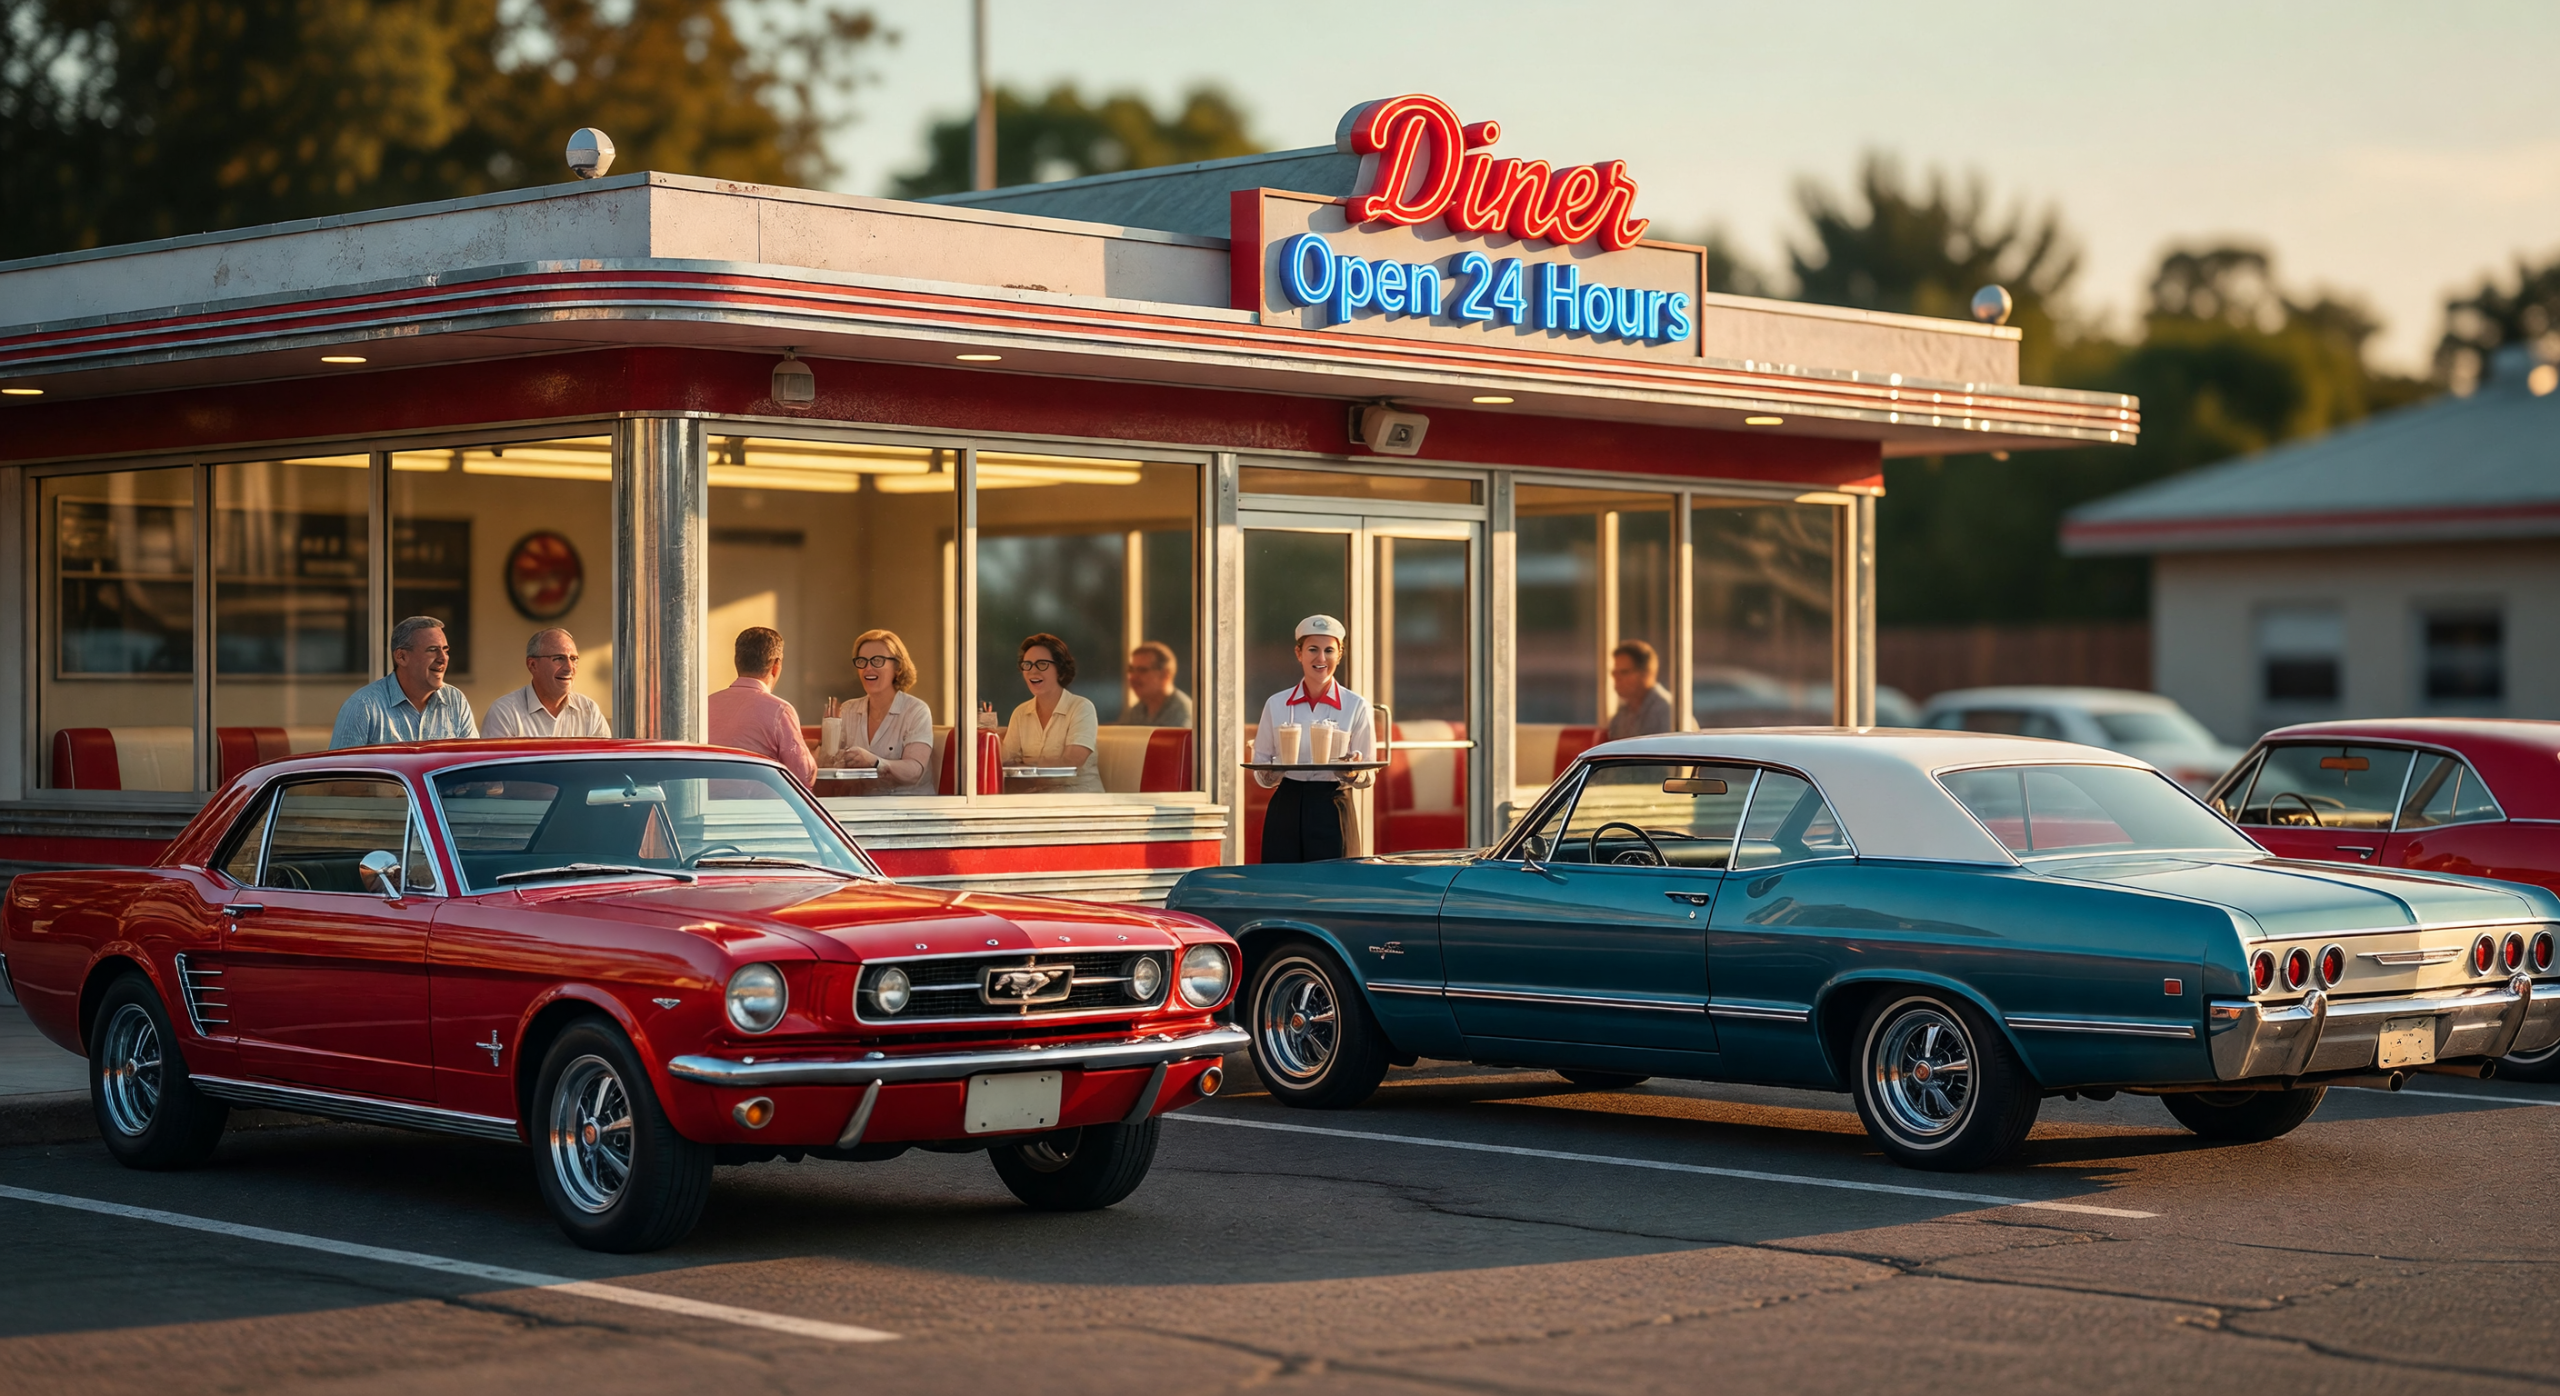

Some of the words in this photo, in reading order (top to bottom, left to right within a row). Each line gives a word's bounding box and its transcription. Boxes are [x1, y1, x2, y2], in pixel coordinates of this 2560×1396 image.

[1348, 93, 1650, 251] Diner
[1282, 232, 1442, 324] Open
[1450, 250, 1528, 324] 24
[1535, 261, 1692, 341] Hours
